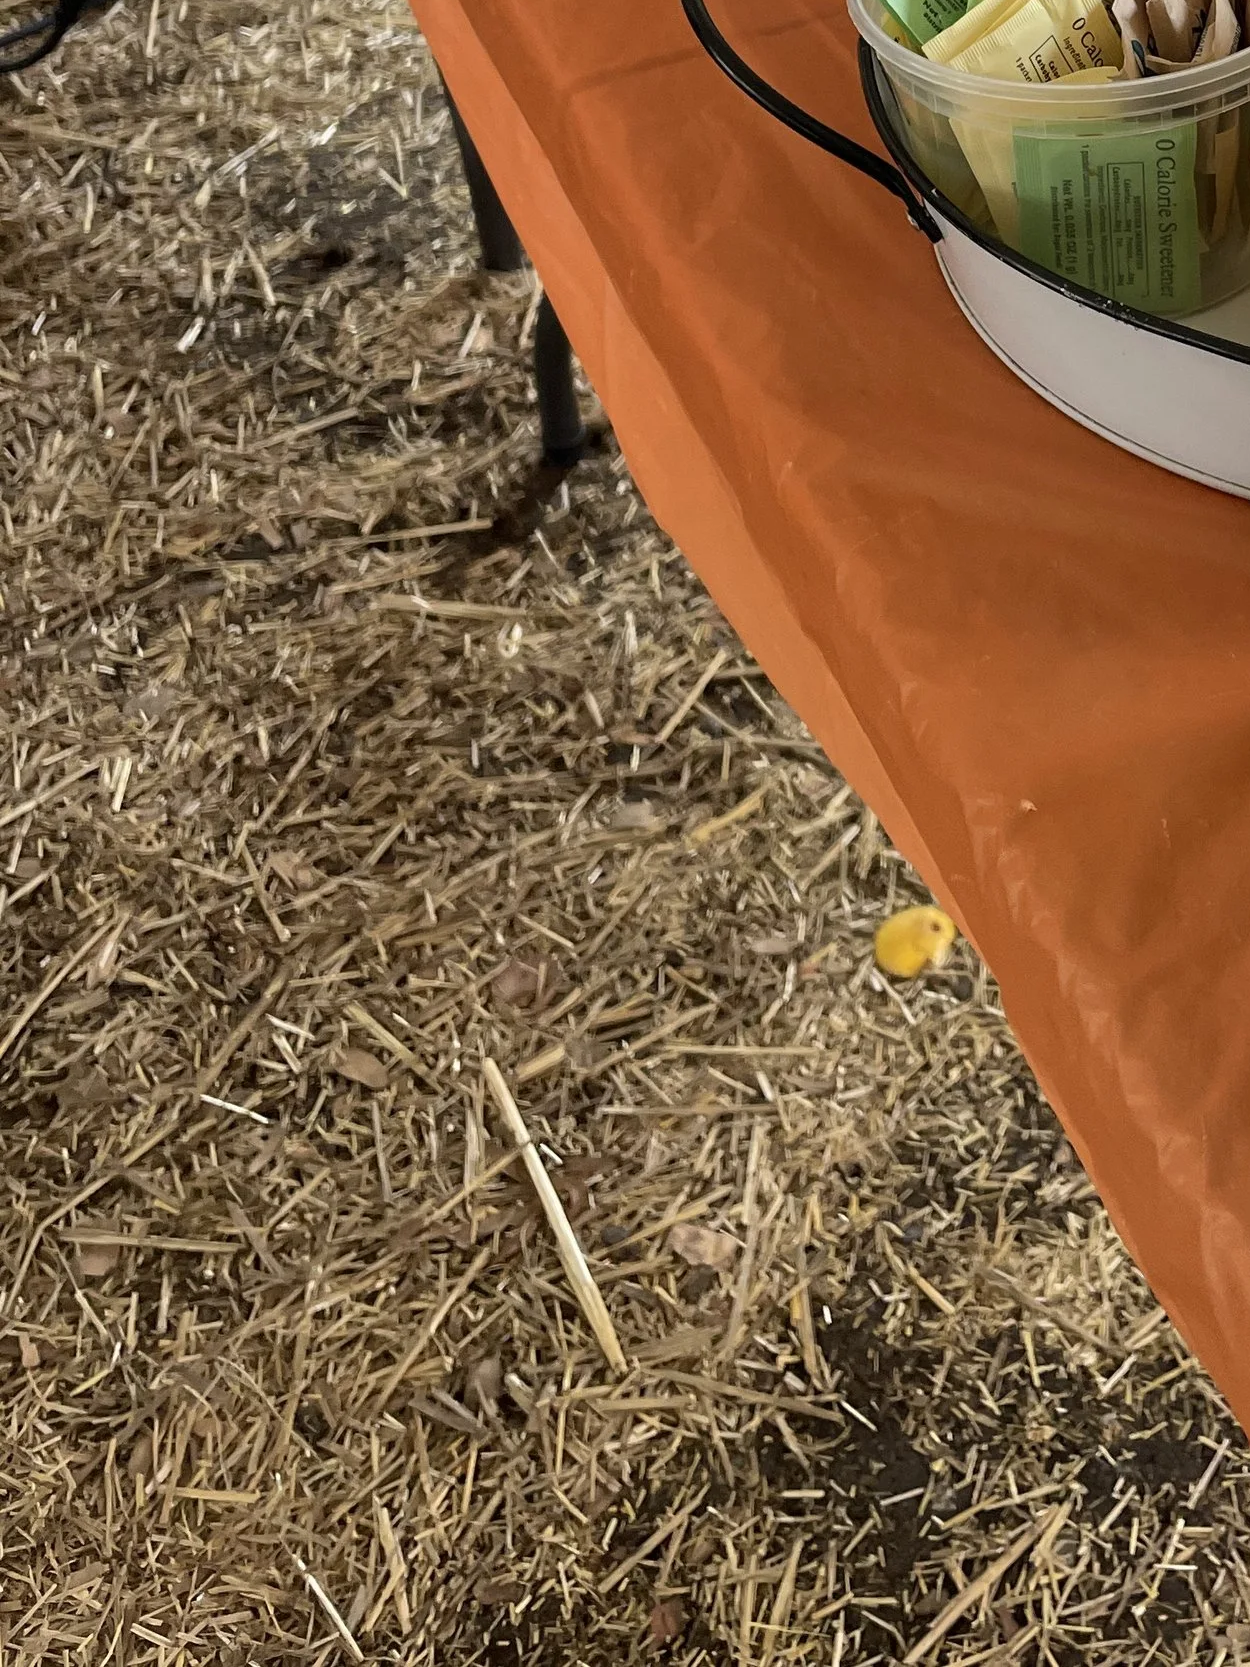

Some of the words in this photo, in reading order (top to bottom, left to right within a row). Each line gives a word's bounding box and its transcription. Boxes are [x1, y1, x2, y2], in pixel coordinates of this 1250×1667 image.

[1072, 17, 1086, 30] 0
[1155, 138, 1175, 151] 0
[1156, 156, 1177, 218] Calorie
[1158, 222, 1178, 298] Sweetener
